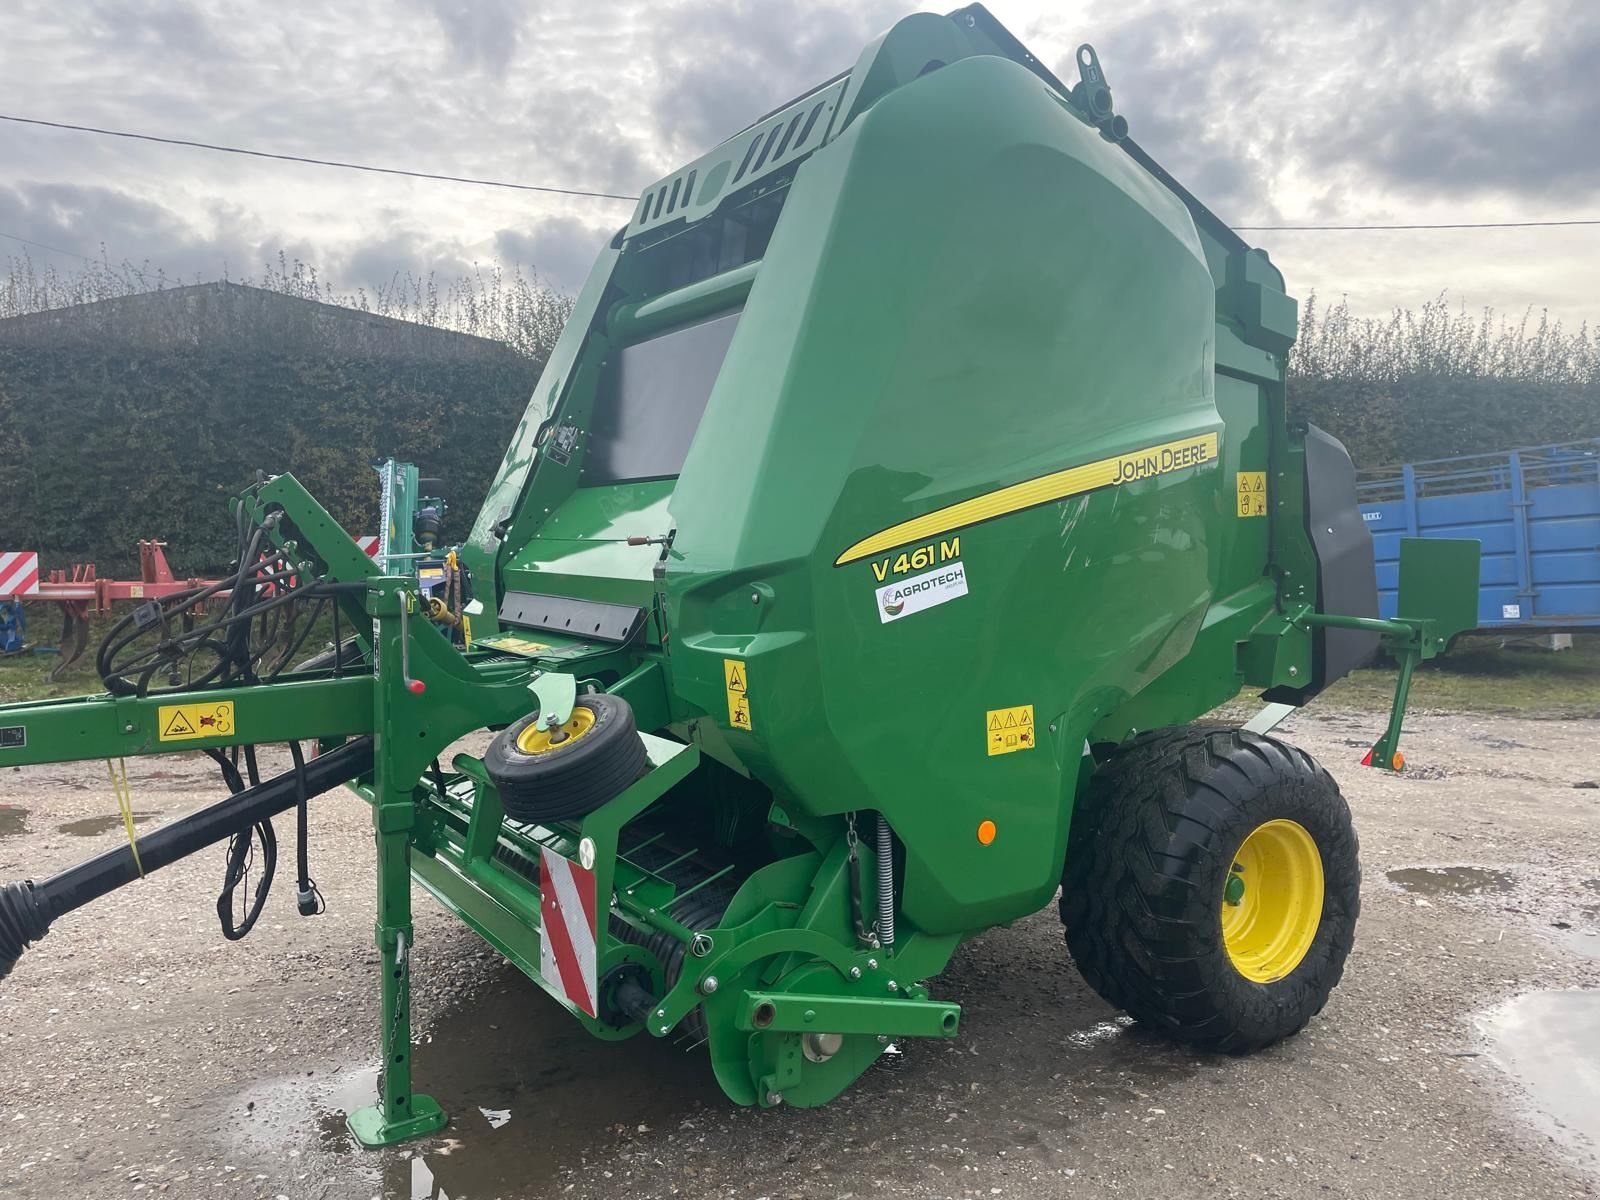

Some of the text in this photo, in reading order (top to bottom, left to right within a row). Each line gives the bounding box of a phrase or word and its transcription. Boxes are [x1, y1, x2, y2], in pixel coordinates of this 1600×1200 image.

[1112, 443, 1207, 483] JOHN DEERE
[871, 536, 961, 582] V 461 M
[894, 569, 964, 601] AGROTECH
